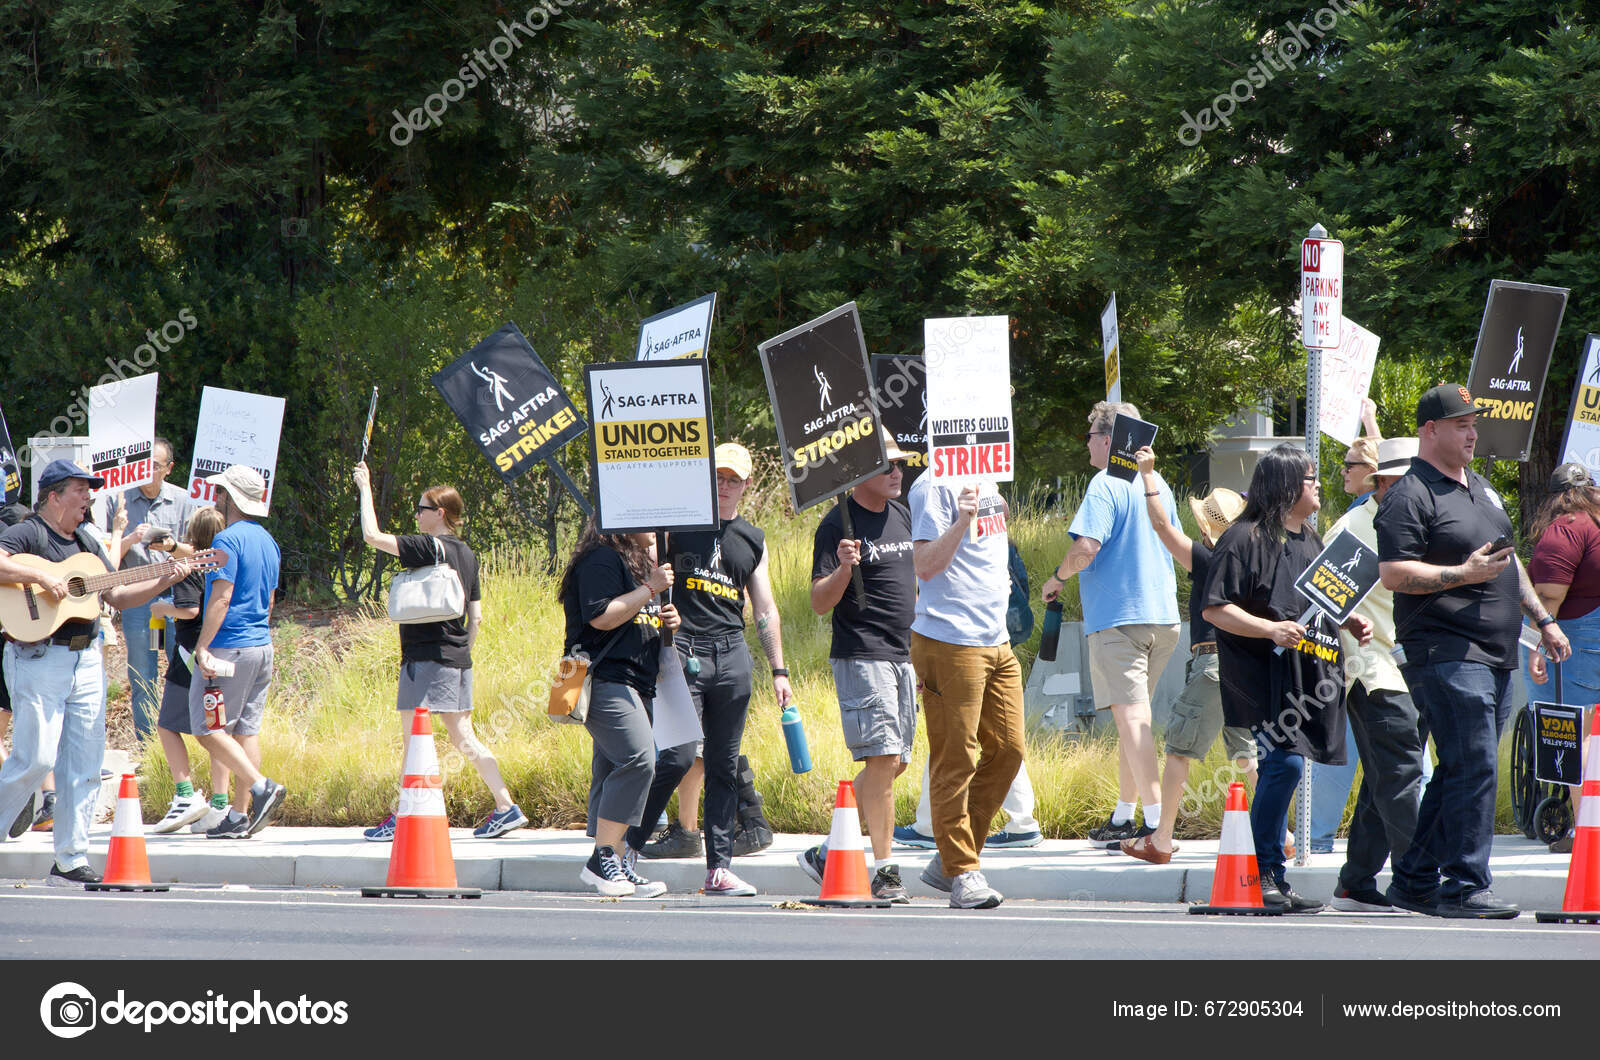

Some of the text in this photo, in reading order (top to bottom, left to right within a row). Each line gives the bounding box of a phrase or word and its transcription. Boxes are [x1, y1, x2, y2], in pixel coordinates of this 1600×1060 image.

[1304, 243, 1318, 268] NO
[1305, 276, 1339, 298] PARKING
[1313, 301, 1329, 317] ANY
[1312, 320, 1330, 336] TIME
[1474, 397, 1534, 421] STRONG
[518, 418, 537, 436] ON
[602, 420, 700, 447] UNIONS
[932, 416, 1008, 434] WRITERS GUILD
[495, 406, 577, 473] STRIKE!
[793, 416, 874, 469] STRONG
[896, 433, 929, 443] SAG·A
[92, 440, 152, 463] WRITERS GUILD
[604, 445, 701, 460] STAND TOGETHER
[934, 443, 1011, 478] STRIKE!
[1110, 455, 1139, 472] STRON
[977, 512, 1006, 537] STRIK
[686, 577, 738, 601] STRONG
[1311, 571, 1349, 608] WGA
[1317, 565, 1356, 598] SUPPORTS
[1541, 717, 1576, 733] WGA
